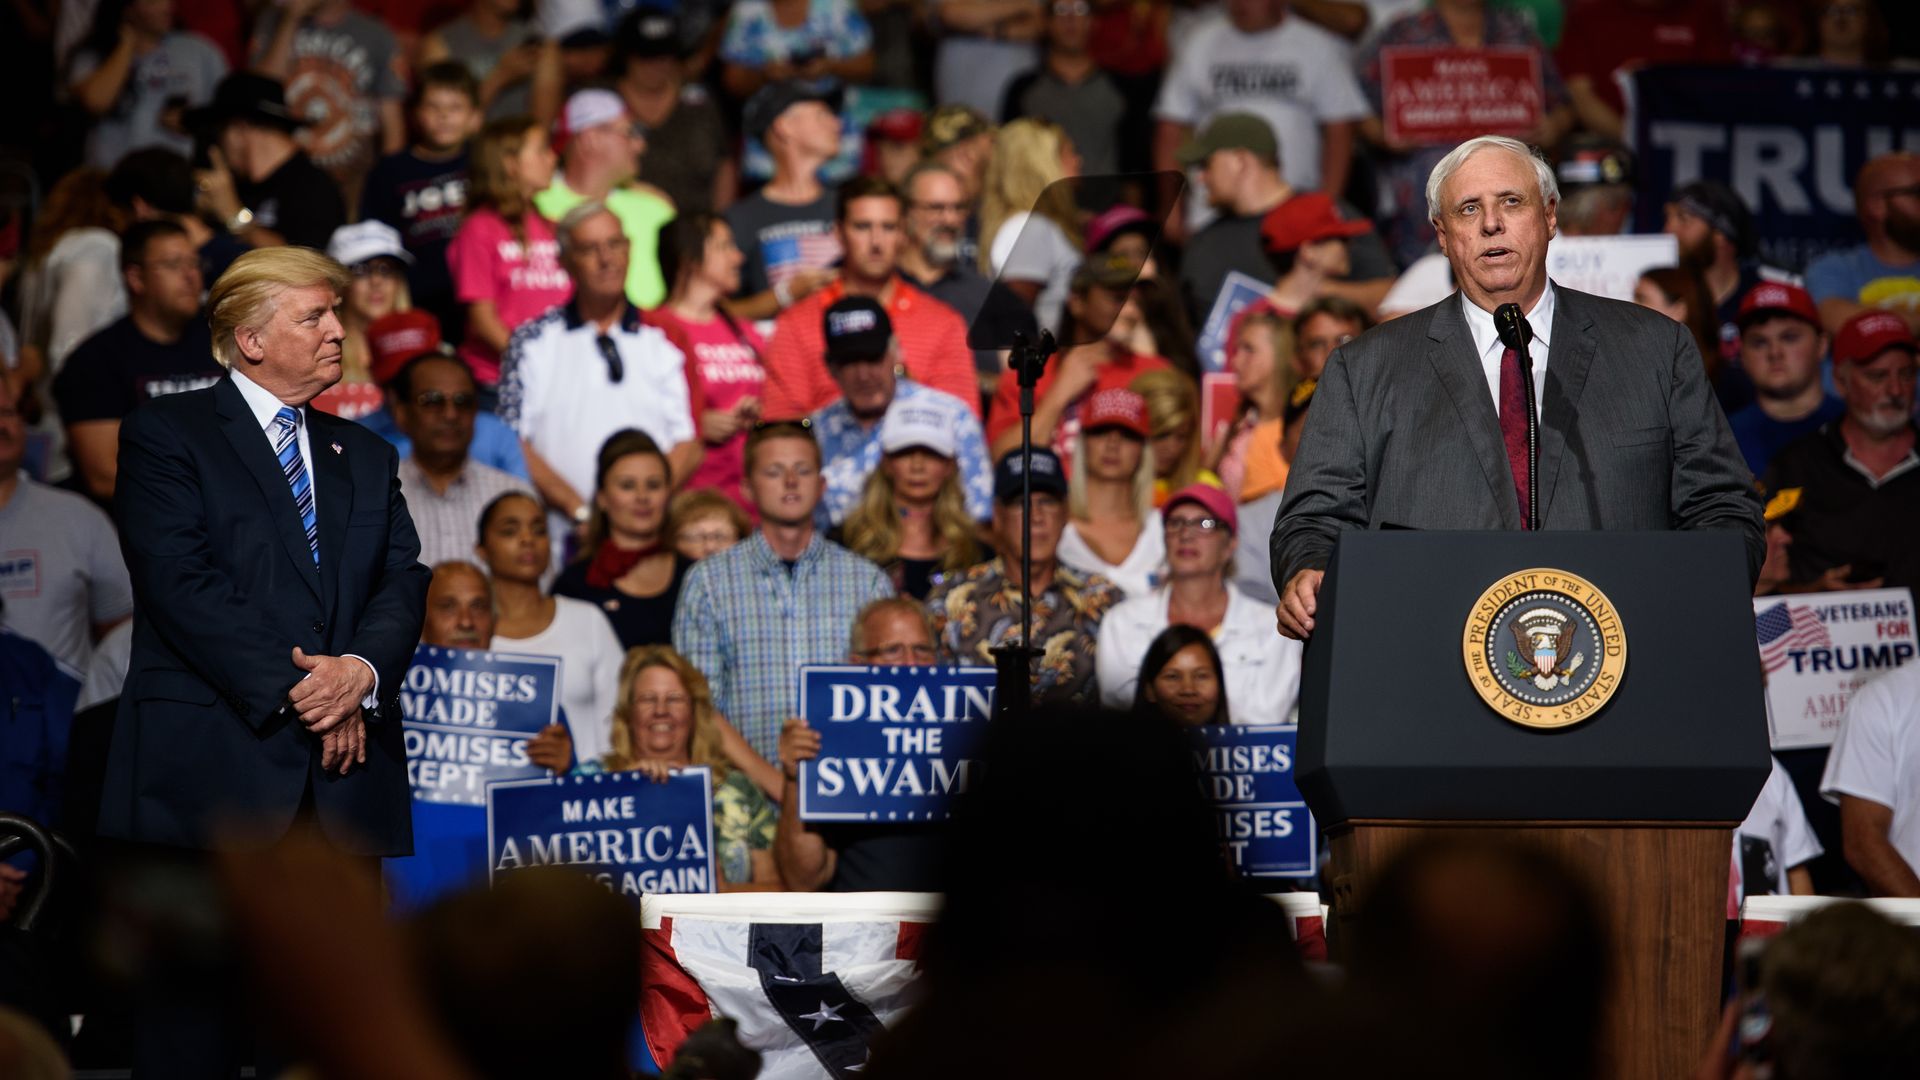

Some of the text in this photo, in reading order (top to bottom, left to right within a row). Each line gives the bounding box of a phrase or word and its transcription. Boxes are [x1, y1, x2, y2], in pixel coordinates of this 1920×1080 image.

[1649, 120, 1920, 216] TRU
[1815, 601, 1909, 622] VETERANS
[1877, 620, 1911, 639] FOR
[1469, 574, 1621, 720] SEAL OF THE PRESIDENT OF THE UNITED STATES
[1788, 644, 1914, 674] TRUMP
[400, 664, 538, 704] OMISES
[401, 694, 499, 728] MADE
[828, 683, 996, 723] DRAIN
[881, 727, 943, 755] THE
[816, 756, 976, 798] SWAM
[562, 796, 636, 823] MAKE
[1216, 809, 1294, 839] ISES
[495, 823, 707, 871] AMERICA
[620, 866, 708, 897] AGAIN
